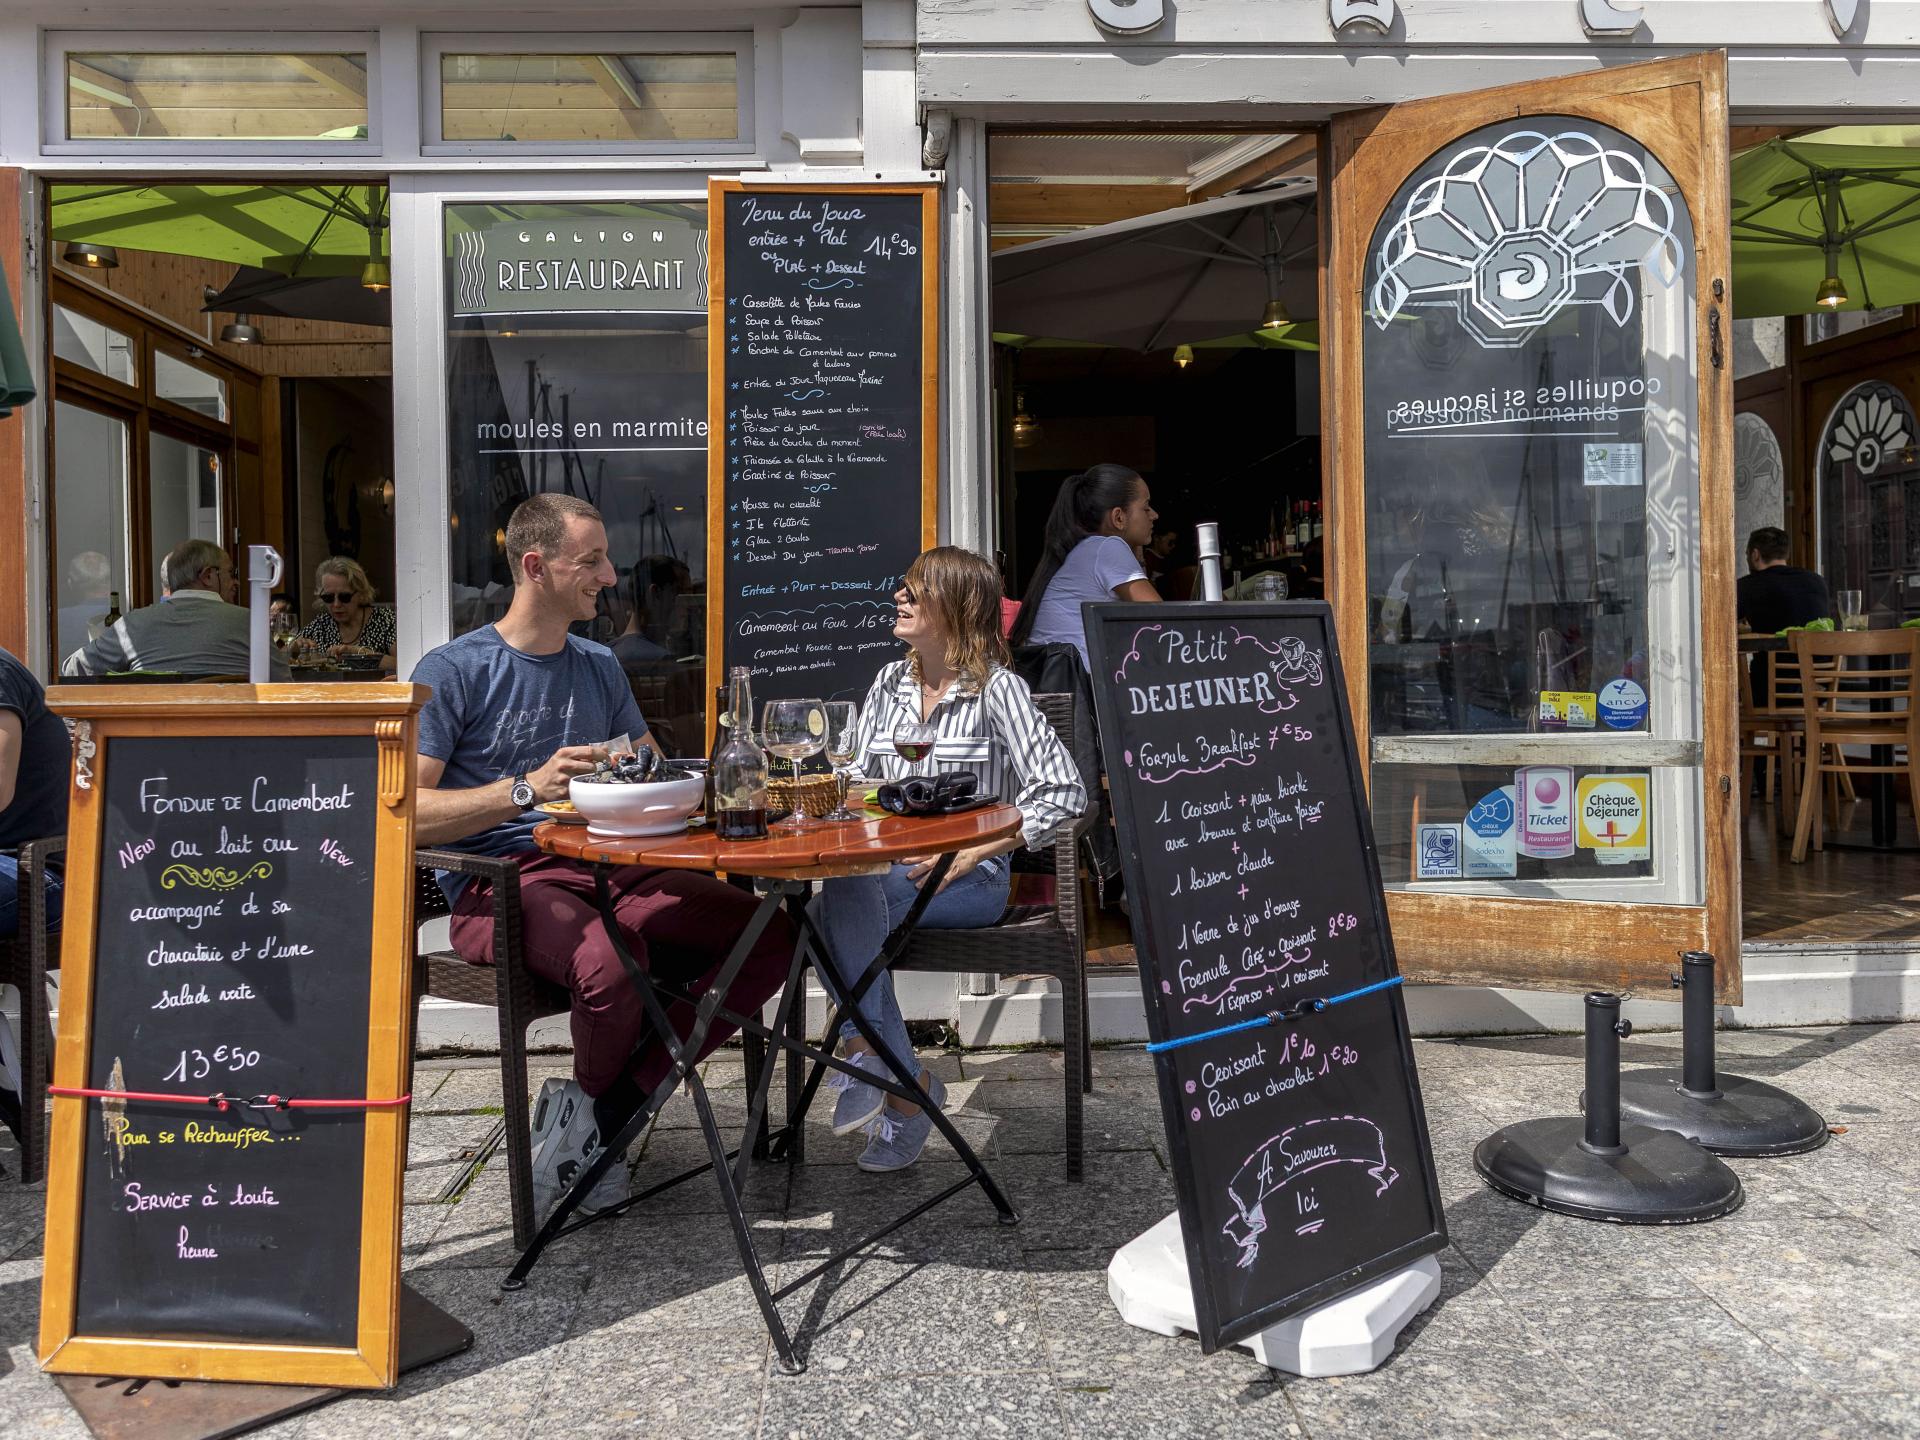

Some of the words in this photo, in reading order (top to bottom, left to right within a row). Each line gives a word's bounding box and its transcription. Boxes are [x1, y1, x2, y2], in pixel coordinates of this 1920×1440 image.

[789, 201, 812, 220] du
[518, 230, 664, 243] GALION
[820, 227, 848, 246] Plat
[498, 258, 684, 291] RESTAURANT
[789, 296, 800, 308] de
[745, 313, 770, 328] Soupe
[774, 315, 785, 326] de
[747, 331, 780, 341] Salade
[783, 346, 794, 355] de
[743, 377, 772, 389] Entrée
[775, 379, 786, 387] du
[784, 424, 794, 432] du
[1387, 404, 1492, 430] poissons
[1503, 402, 1619, 422] normands
[477, 418, 563, 439] moules
[574, 422, 601, 438] en
[612, 418, 709, 438] marmite
[769, 437, 779, 447] du
[816, 437, 828, 447] du
[784, 455, 794, 464] de
[837, 453, 845, 463] la
[784, 471, 795, 480] de
[777, 536, 783, 544] 2
[739, 618, 800, 636] Camembert
[801, 622, 818, 631] au
[1158, 629, 1227, 664] Petit
[1128, 672, 1276, 715] DEJEUNER
[1140, 742, 1190, 769] Formule
[1196, 728, 1261, 763] Breakfast
[251, 776, 354, 814] Camembert
[1181, 791, 1233, 821] Croissant
[1590, 794, 1636, 807] Chèque
[1529, 815, 1568, 826] Ticket
[1586, 806, 1640, 820] Déjeuner
[1165, 837, 1188, 852] avec
[1256, 807, 1293, 834] confiture
[171, 840, 202, 858] au
[215, 826, 253, 855] lait
[1190, 867, 1232, 891] boisson
[1237, 848, 1275, 876] chaude
[241, 892, 260, 916] de
[271, 899, 292, 914] sa
[1227, 914, 1239, 933] de
[1243, 910, 1260, 936] jus
[231, 942, 252, 961] et
[257, 936, 314, 960] d'une
[1178, 954, 1231, 994] Formule
[152, 983, 211, 1010] salade
[1201, 1042, 1267, 1090] Croissant
[1207, 1089, 1240, 1118] Pain
[1243, 1089, 1261, 1105] au
[1265, 1066, 1316, 1098] chocolat
[158, 1131, 175, 1143] se
[1257, 1150, 1274, 1186] A
[1279, 1135, 1337, 1172] Savourer
[202, 1184, 218, 1207] à
[230, 1183, 279, 1207] toute
[1296, 1187, 1319, 1215] Ici
[177, 1225, 218, 1259] heure
